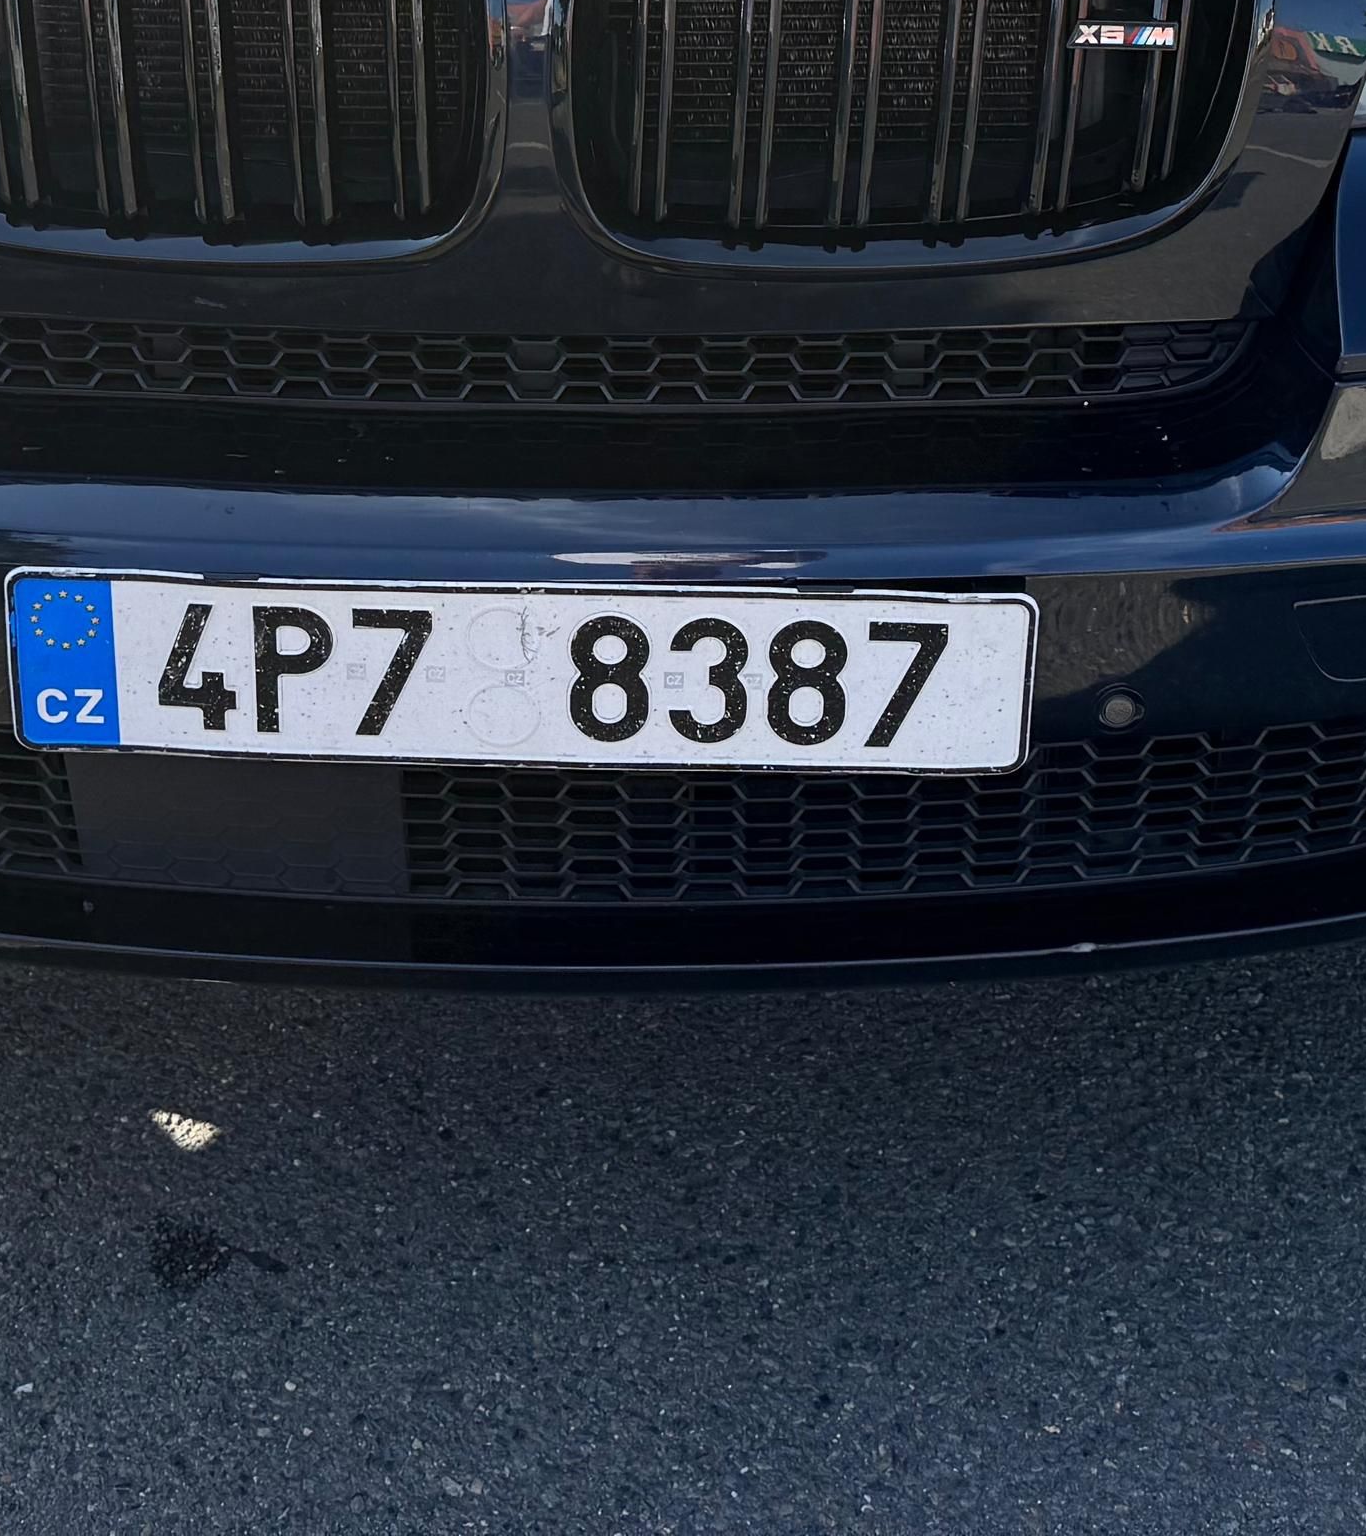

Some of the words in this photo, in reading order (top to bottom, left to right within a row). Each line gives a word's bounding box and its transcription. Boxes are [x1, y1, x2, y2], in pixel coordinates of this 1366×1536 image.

[36, 688, 105, 724] CZ
[159, 603, 434, 736] 4P7
[569, 615, 950, 747] 8387
